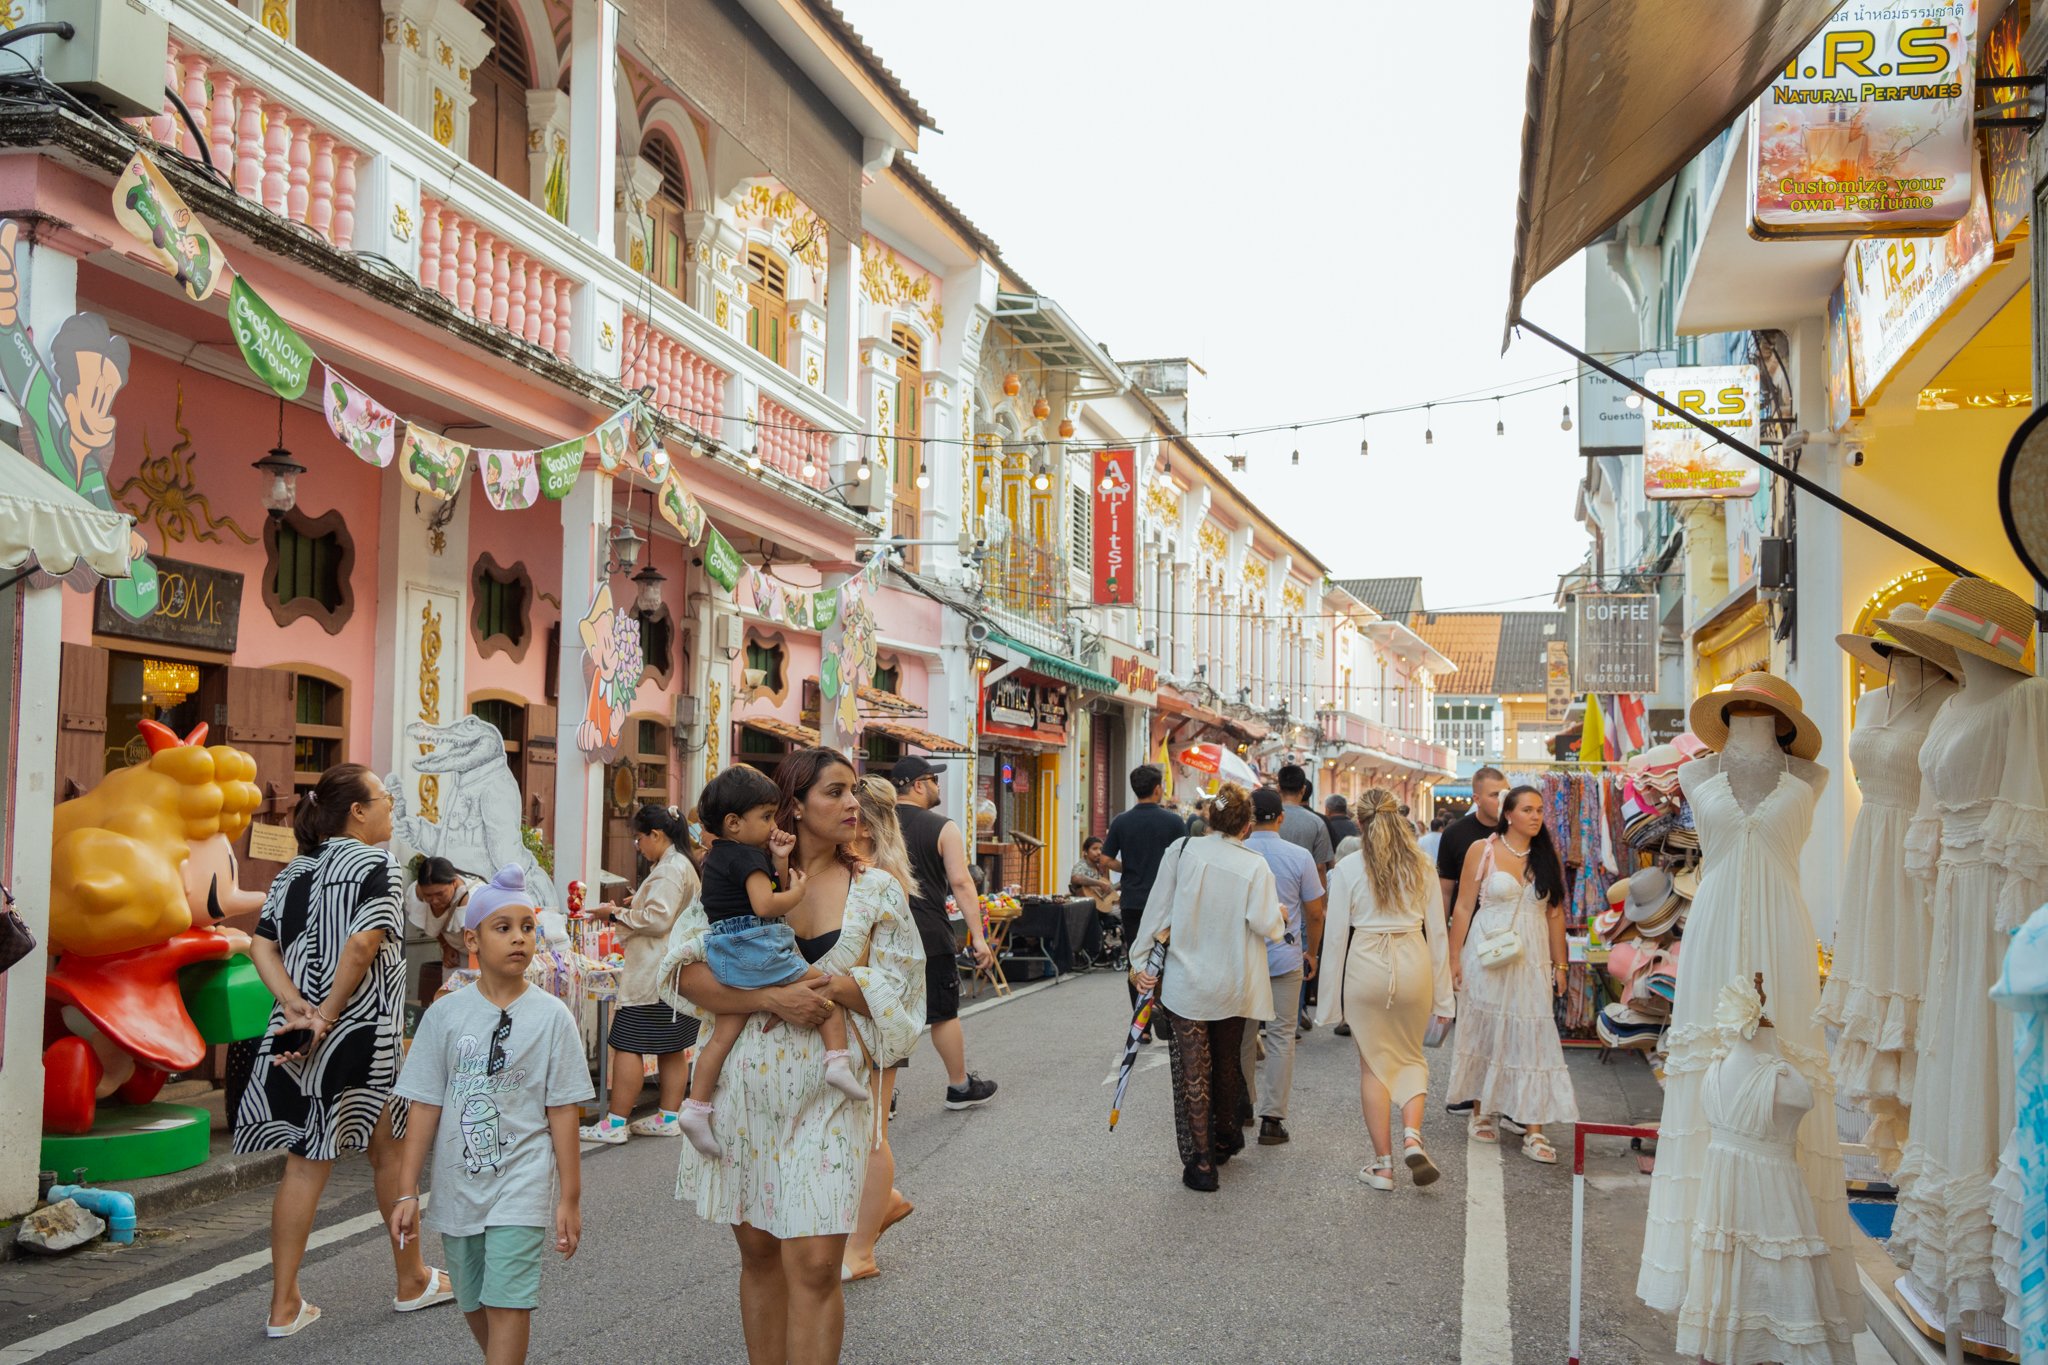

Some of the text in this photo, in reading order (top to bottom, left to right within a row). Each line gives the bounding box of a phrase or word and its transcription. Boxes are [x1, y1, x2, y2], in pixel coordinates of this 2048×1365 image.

[1780, 177, 1945, 196] Customize your
[1790, 194, 1933, 212] own Perfume
[138, 201, 157, 225] Grab
[236, 295, 303, 370] Grab Now
[13, 331, 34, 368] Grab
[251, 340, 301, 388] Around
[1588, 375, 1607, 385] The
[1657, 387, 1746, 417] I.R.S
[548, 475, 563, 490] Go
[137, 578, 156, 595] Grab
[1586, 604, 1649, 620] COFFEE
[1600, 663, 1635, 673] CRAFT
[1584, 673, 1650, 683] CHOCOLATE
